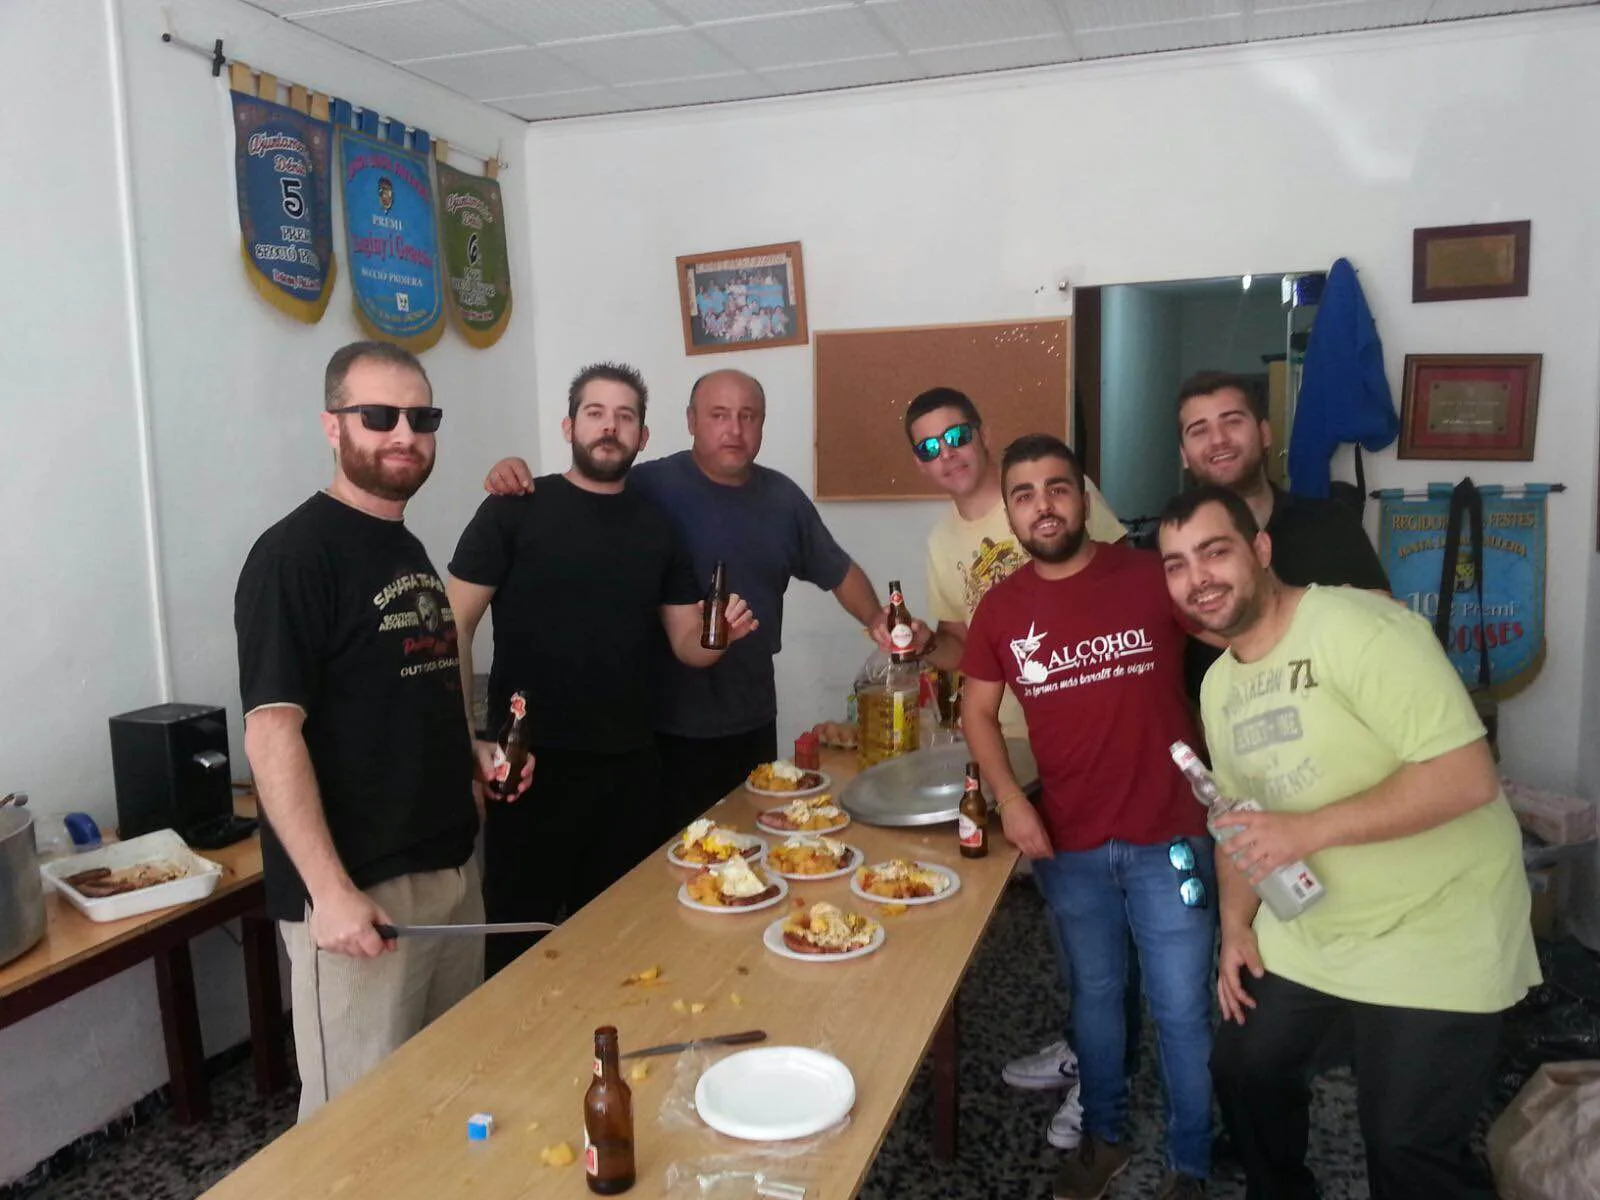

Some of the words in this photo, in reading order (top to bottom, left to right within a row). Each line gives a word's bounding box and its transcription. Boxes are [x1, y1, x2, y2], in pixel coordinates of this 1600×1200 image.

[280, 177, 305, 219] 5
[372, 214, 402, 231] PREMI
[1489, 512, 1537, 530] FESTES
[1048, 628, 1153, 669] ALCOHOL
[1074, 651, 1121, 669] VIAJES
[1032, 684, 1058, 698] forma
[1060, 677, 1078, 690] más
[1080, 668, 1112, 685] barata
[1113, 665, 1125, 677] de
[1127, 661, 1155, 675] viajar
[1288, 659, 1318, 694] 71
